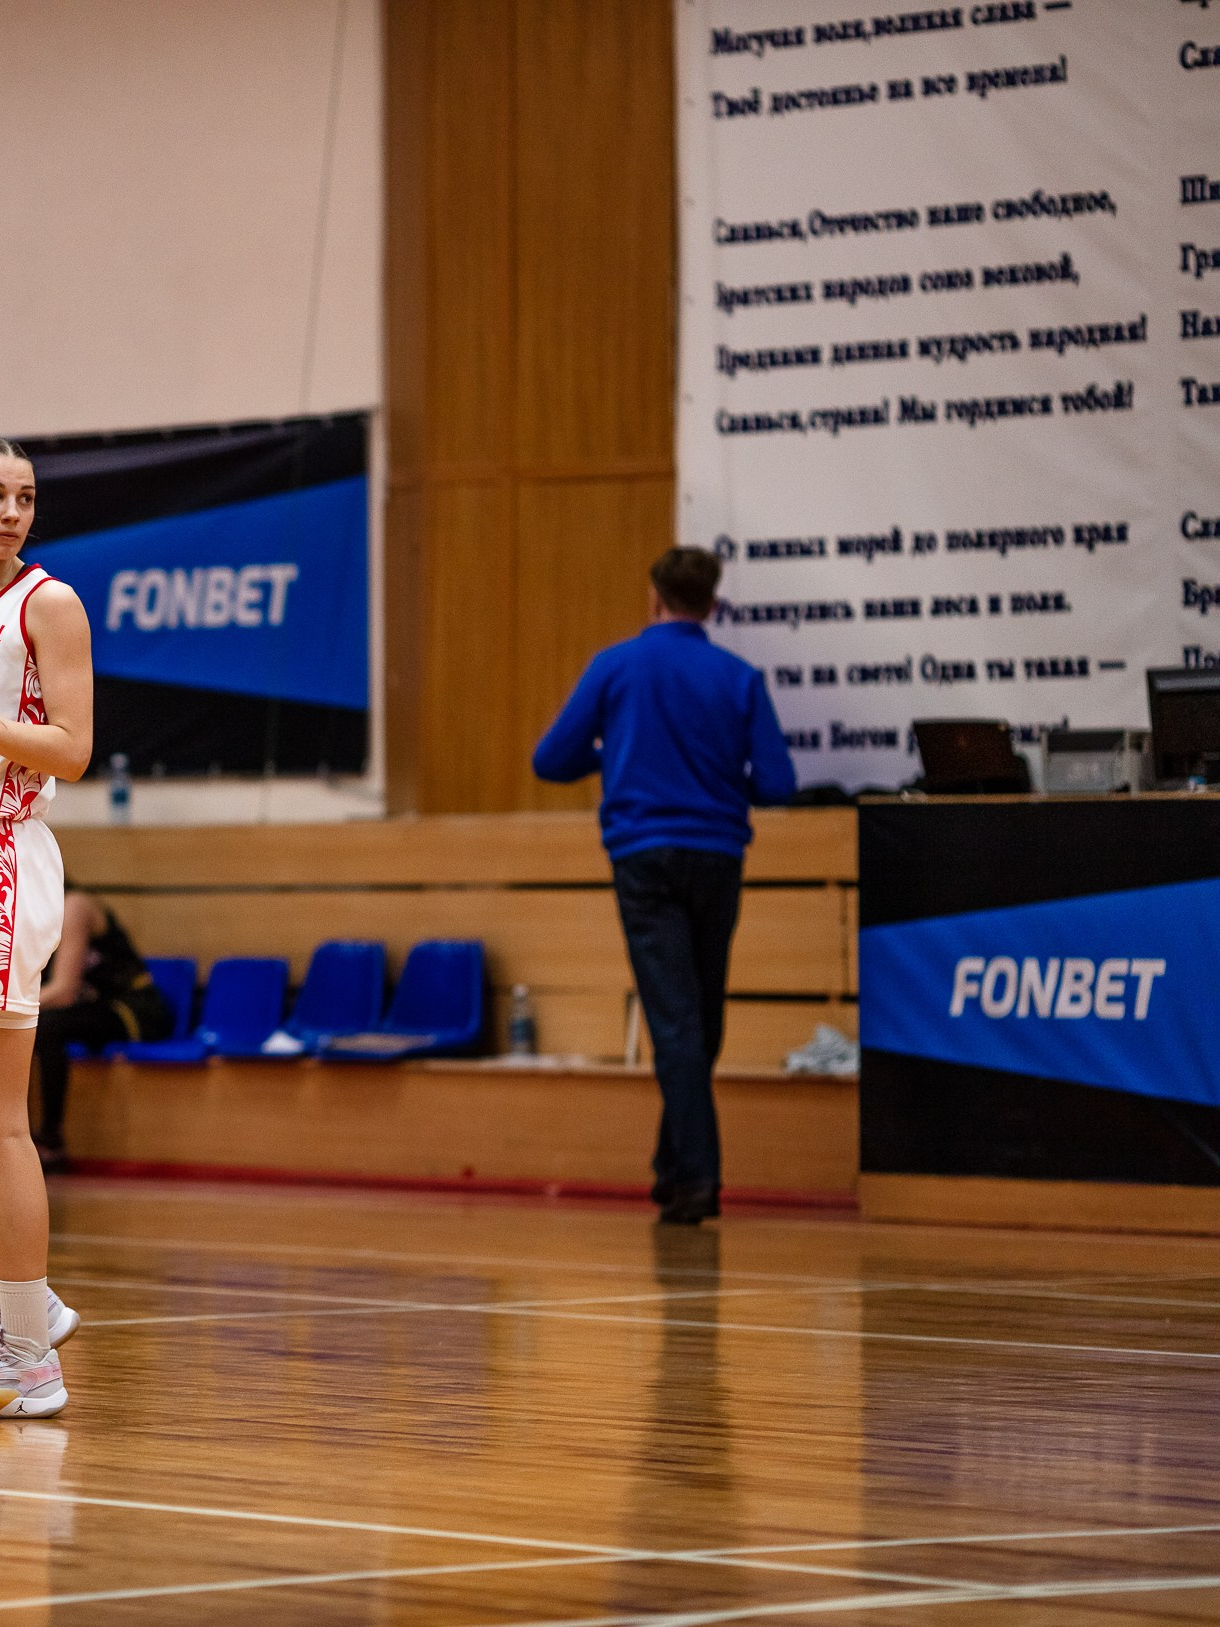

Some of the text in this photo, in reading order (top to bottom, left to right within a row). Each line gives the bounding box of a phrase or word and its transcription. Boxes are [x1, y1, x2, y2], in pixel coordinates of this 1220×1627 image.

[887, 79, 914, 101] на
[922, 74, 958, 98] все
[927, 202, 985, 227] наше
[898, 394, 938, 424] Мы
[945, 393, 1053, 428] гордимся
[1060, 380, 1135, 413] тобой!
[911, 530, 939, 557] до
[105, 562, 299, 632] FONBET
[921, 654, 976, 687] Одна
[986, 658, 1016, 681] ты
[1024, 656, 1090, 681] такая
[948, 955, 1167, 1020] FONBET
